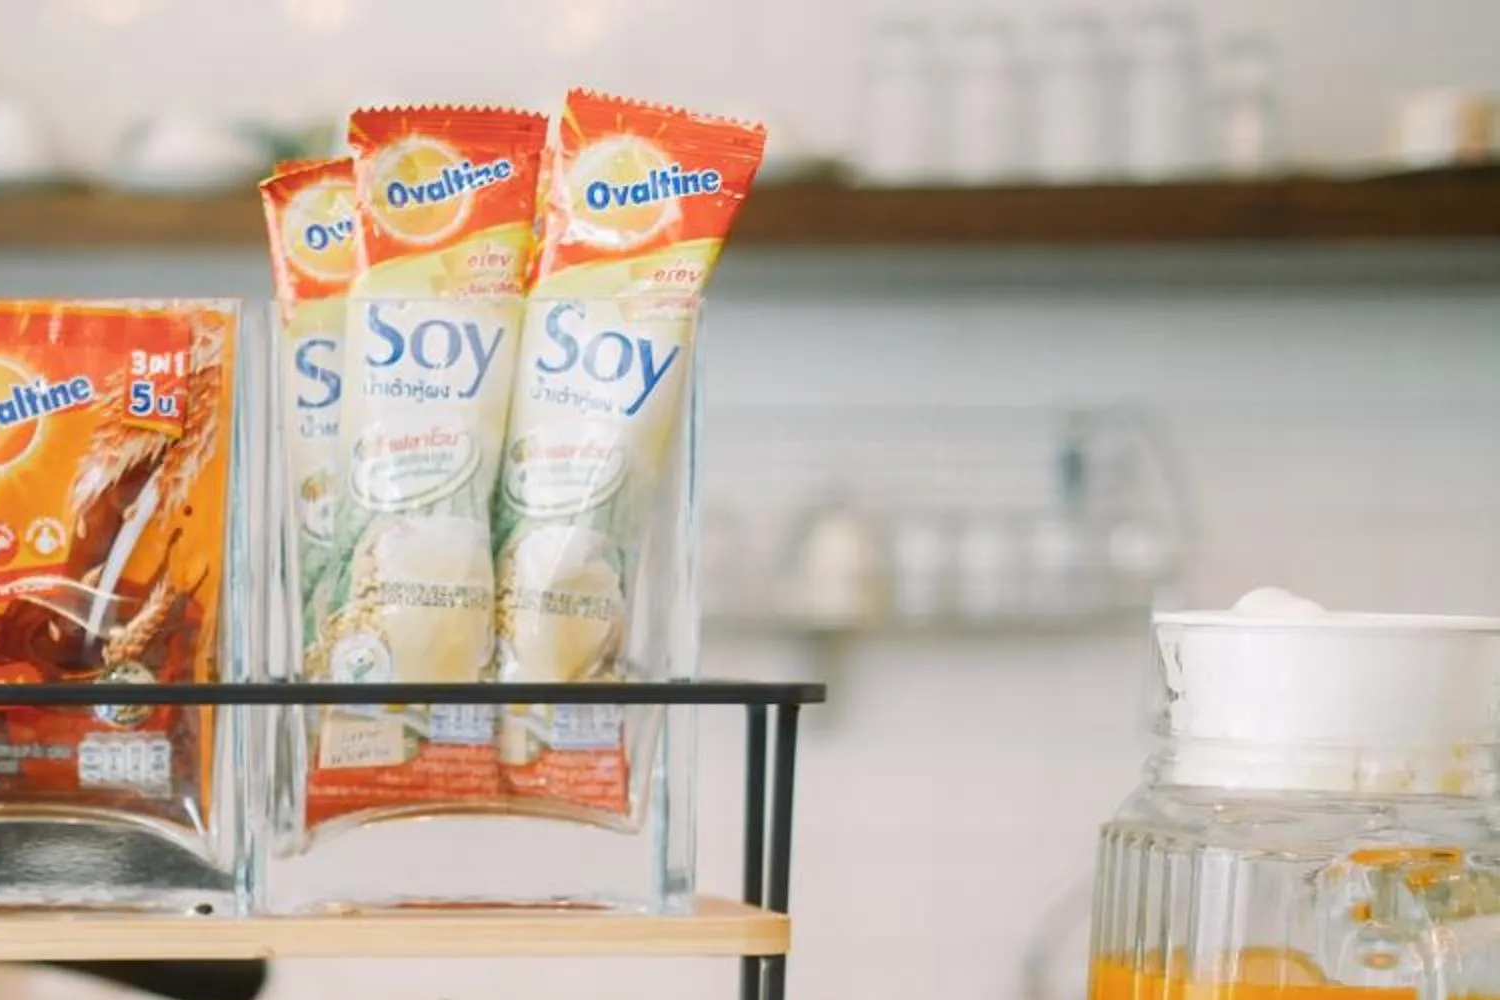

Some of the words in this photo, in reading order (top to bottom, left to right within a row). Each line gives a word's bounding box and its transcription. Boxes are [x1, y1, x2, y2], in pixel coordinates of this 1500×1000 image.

[386, 159, 512, 209] Ovaltine
[585, 167, 723, 211] Ovaltine
[366, 302, 505, 398] Soy
[536, 301, 679, 416] Soy
